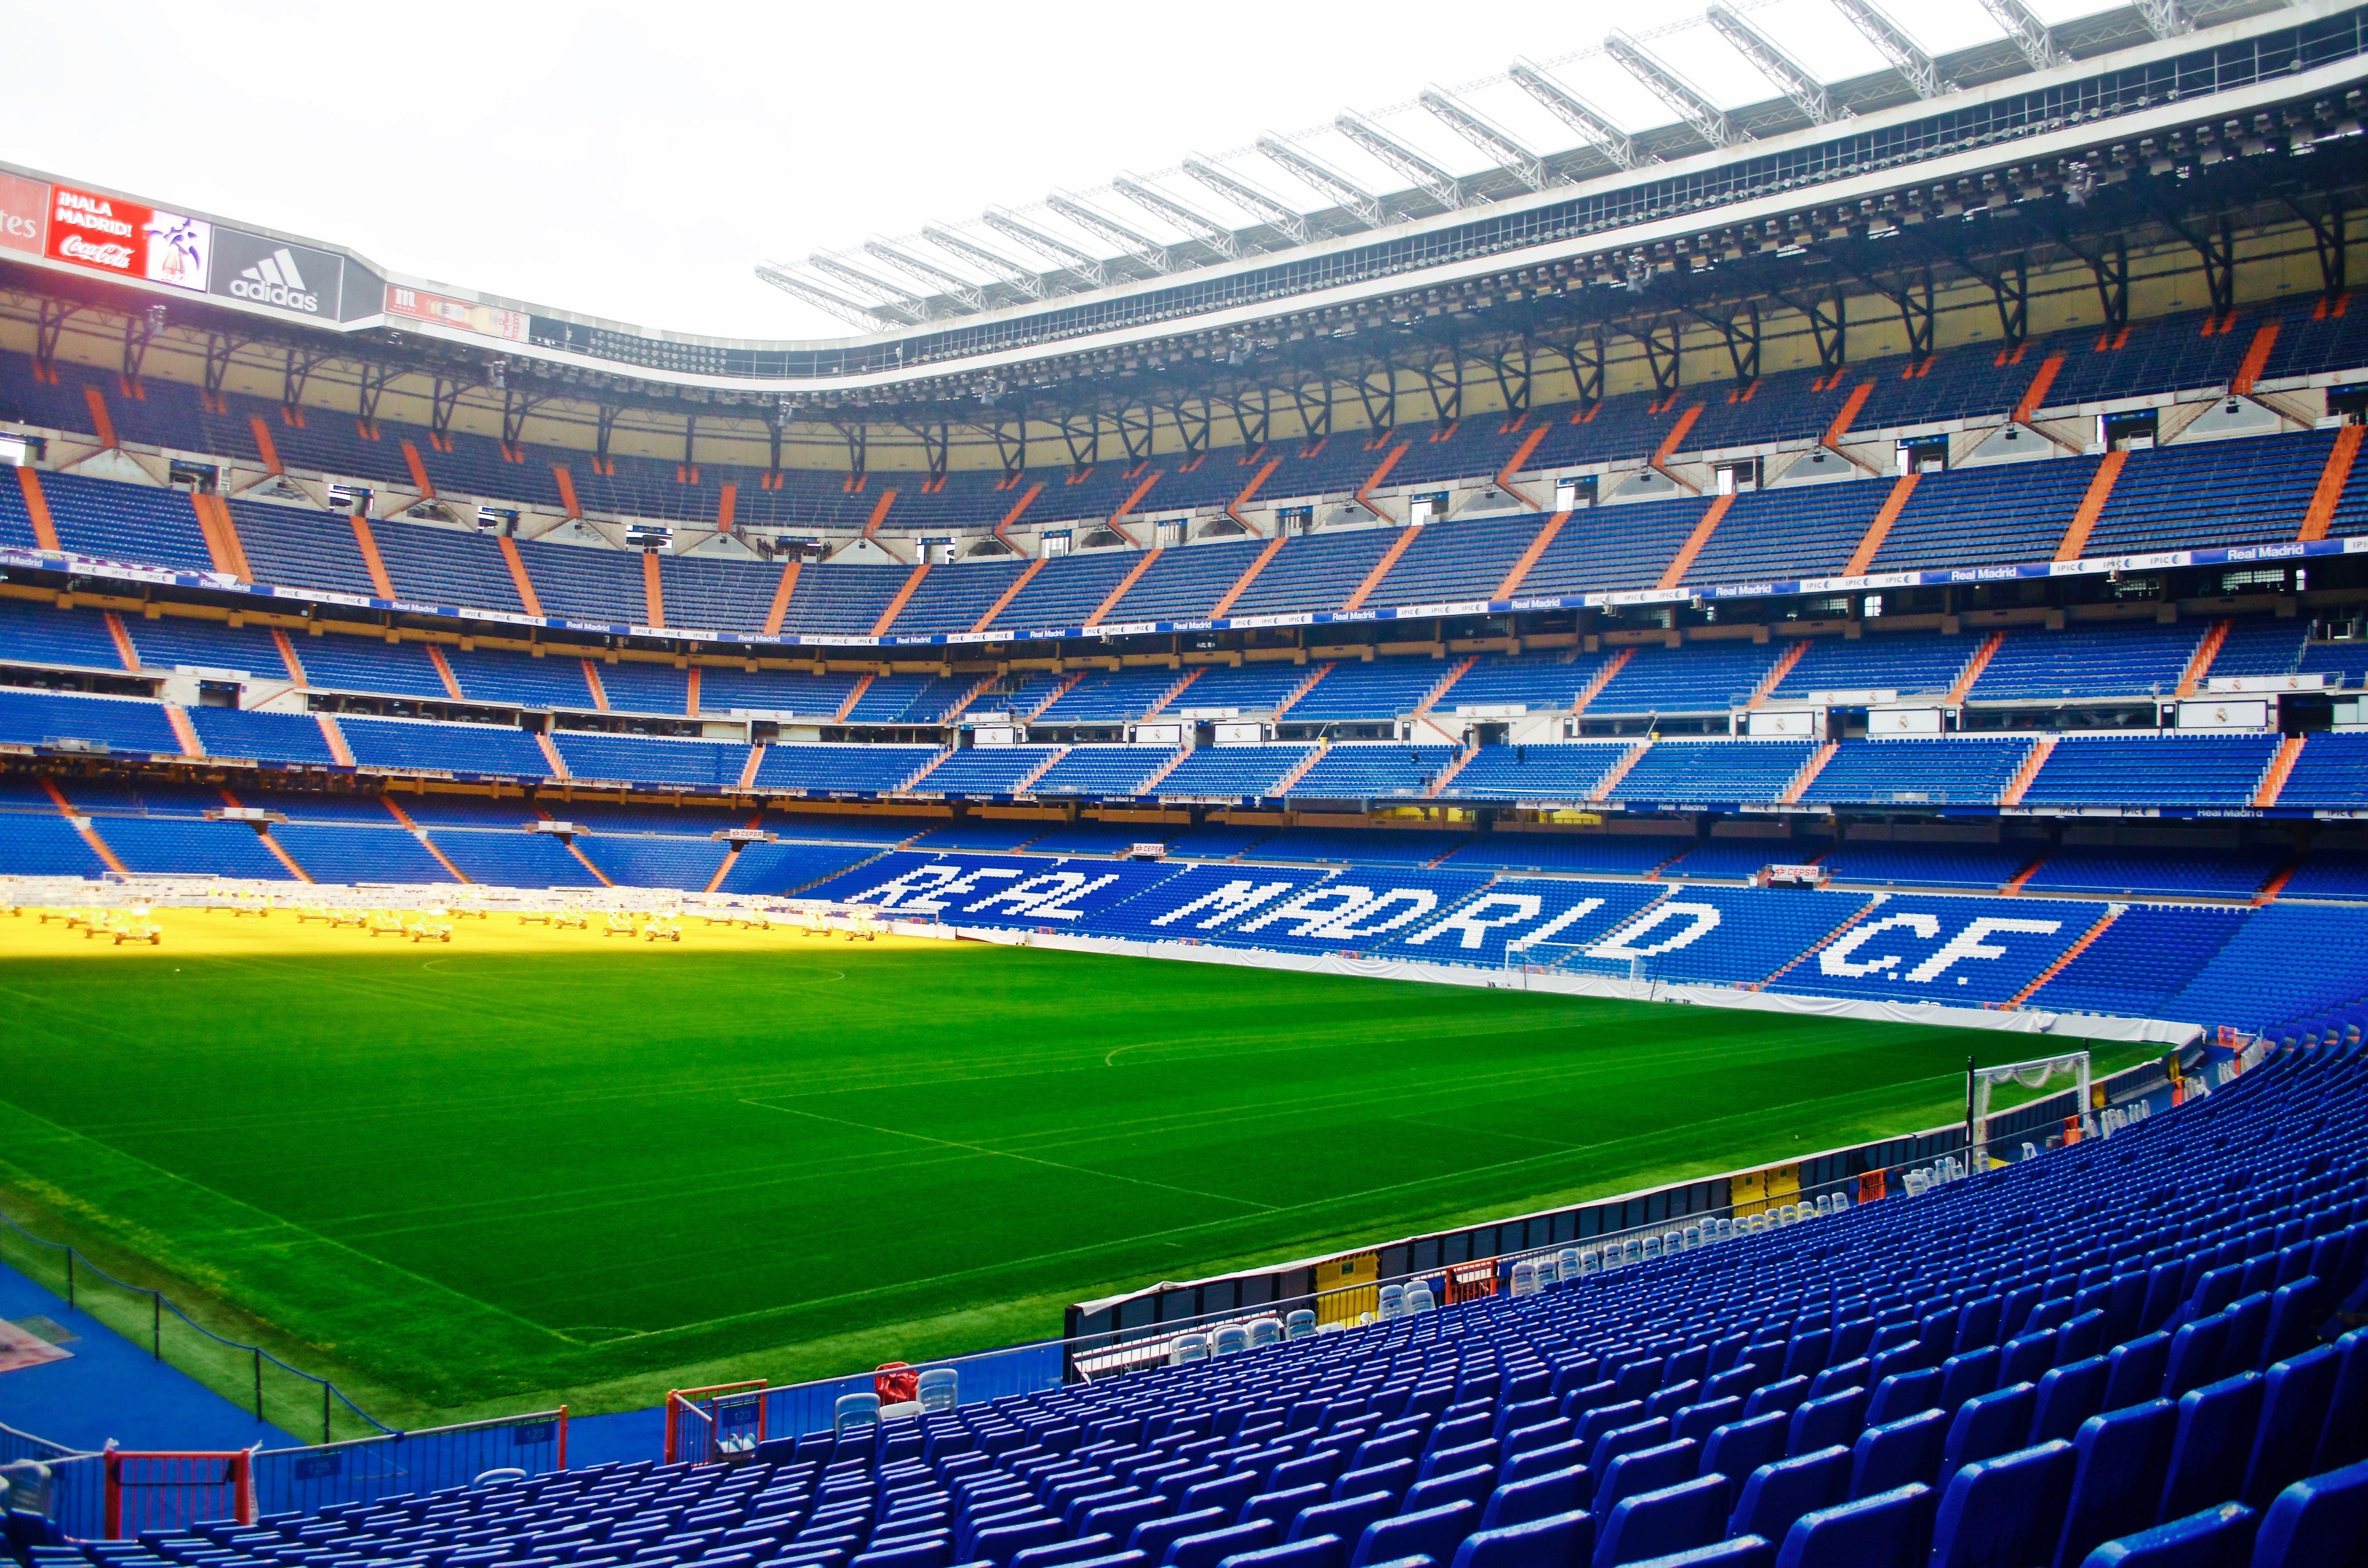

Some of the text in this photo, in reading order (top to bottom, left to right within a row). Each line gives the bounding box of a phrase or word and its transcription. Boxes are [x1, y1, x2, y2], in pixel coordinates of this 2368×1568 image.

[60, 192, 112, 217] ¡HALA
[57, 207, 132, 237] MADRID!
[230, 280, 318, 313] adidas
[2227, 544, 2305, 560] Real Madrid
[10, 555, 43, 567] Madrid
[1951, 567, 2017, 581] Real Madrid
[200, 579, 219, 588] Real
[1715, 584, 1772, 596] Real Madrid
[393, 601, 438, 613] Real Madrid
[1511, 599, 1560, 610] Real Madrid
[1332, 611, 1375, 621] Real Madrid
[567, 621, 610, 632] Real Madrid
[1189, 621, 1212, 629] Madrid
[756, 635, 780, 643] Madrid
[2197, 809, 2221, 817] Real
[1788, 868, 1816, 876] CEPSA
[1150, 880, 1720, 959] MADRID
[734, 1409, 752, 1422] 123
[525, 1427, 546, 1439] 123
